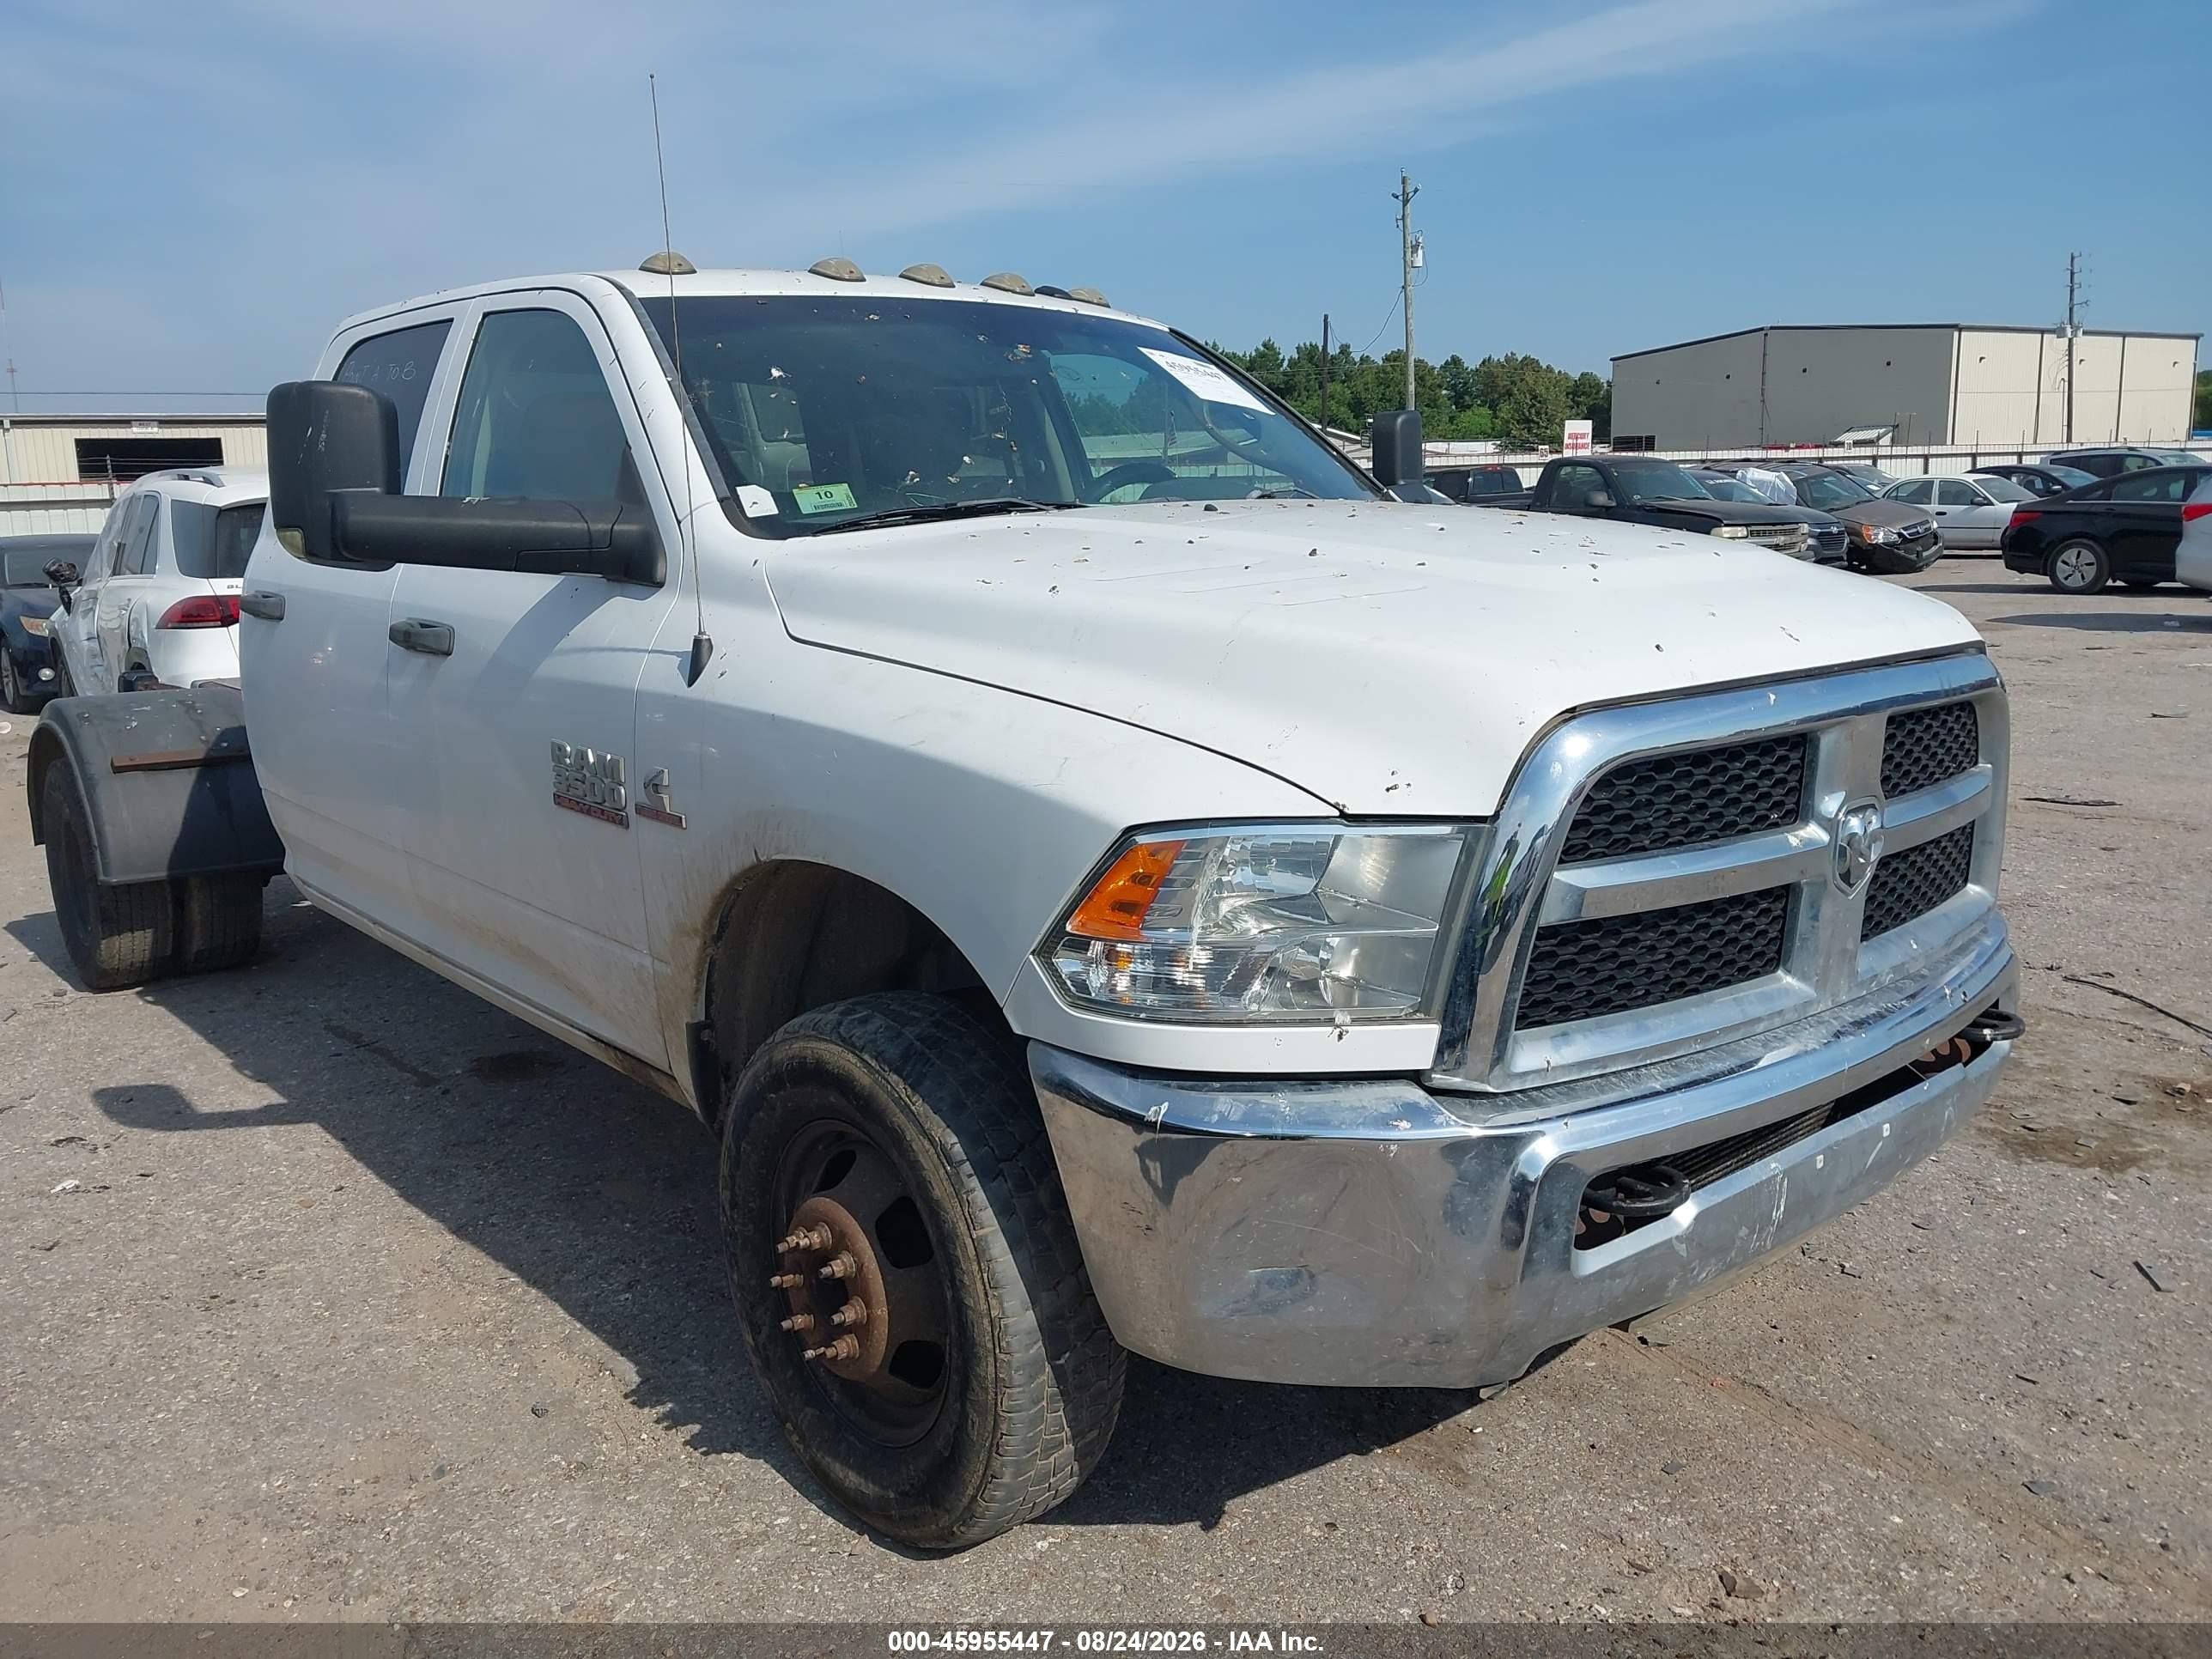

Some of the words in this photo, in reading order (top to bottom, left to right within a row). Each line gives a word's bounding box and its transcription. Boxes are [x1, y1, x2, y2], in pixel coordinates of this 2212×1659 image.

[815, 490, 833, 500] 10
[550, 738, 625, 784] RAM
[552, 764, 627, 811] 3500
